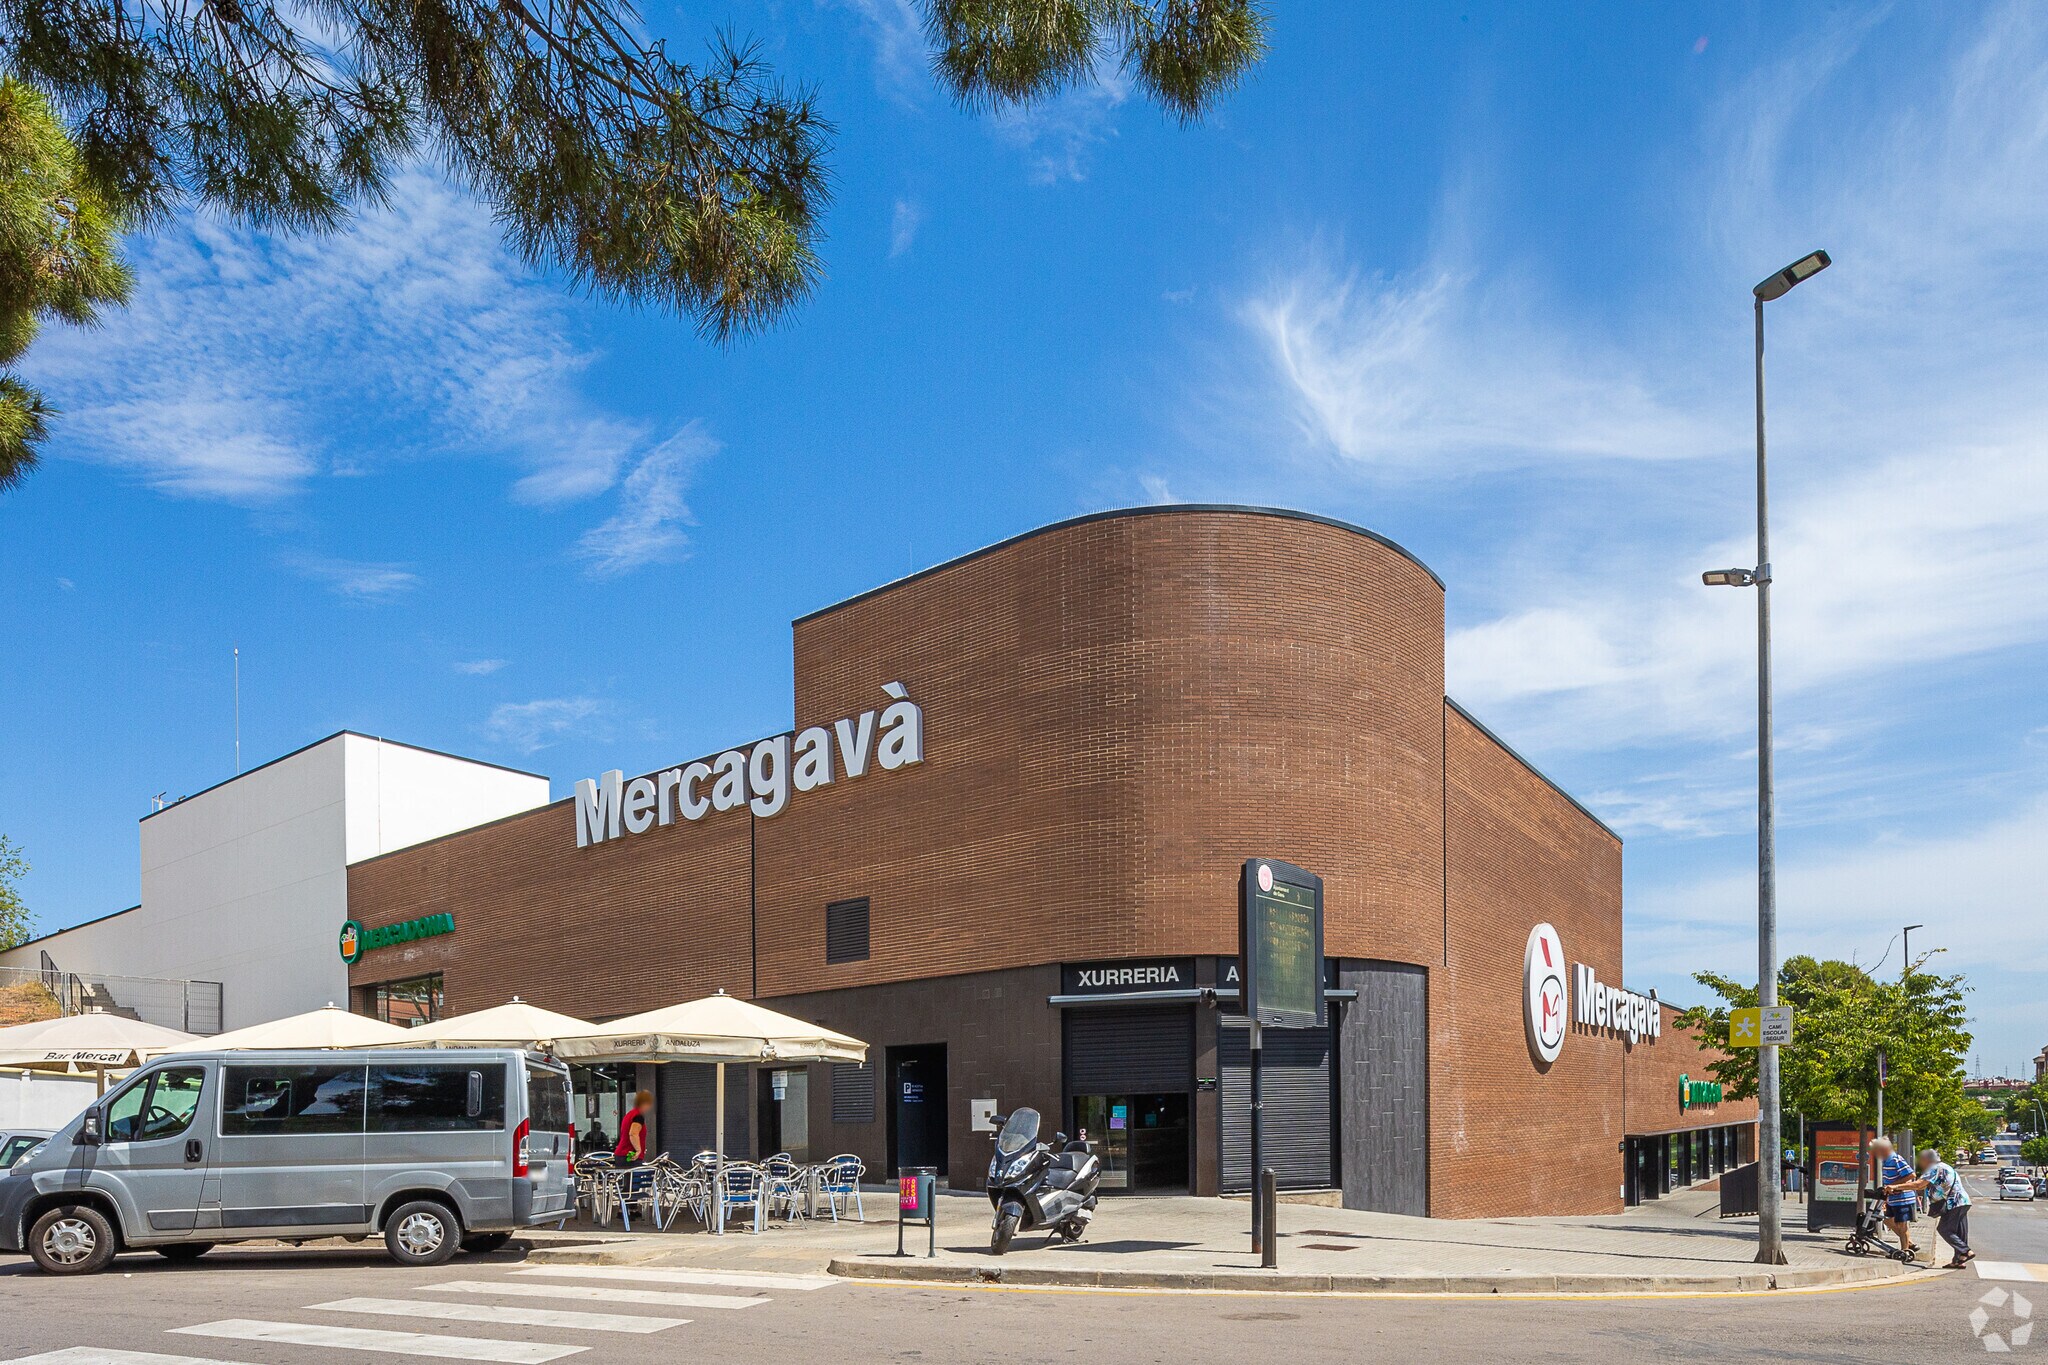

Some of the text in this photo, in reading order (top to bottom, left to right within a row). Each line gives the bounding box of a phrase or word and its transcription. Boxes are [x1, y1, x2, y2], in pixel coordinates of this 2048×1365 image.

[575, 681, 924, 848] Mercagavà
[1078, 966, 1180, 987] XURRERIA
[1571, 960, 1661, 1045] Mercagavà
[613, 1039, 701, 1048] XURRERIA ANDALUZA
[44, 1051, 123, 1062] Bar Mercat
